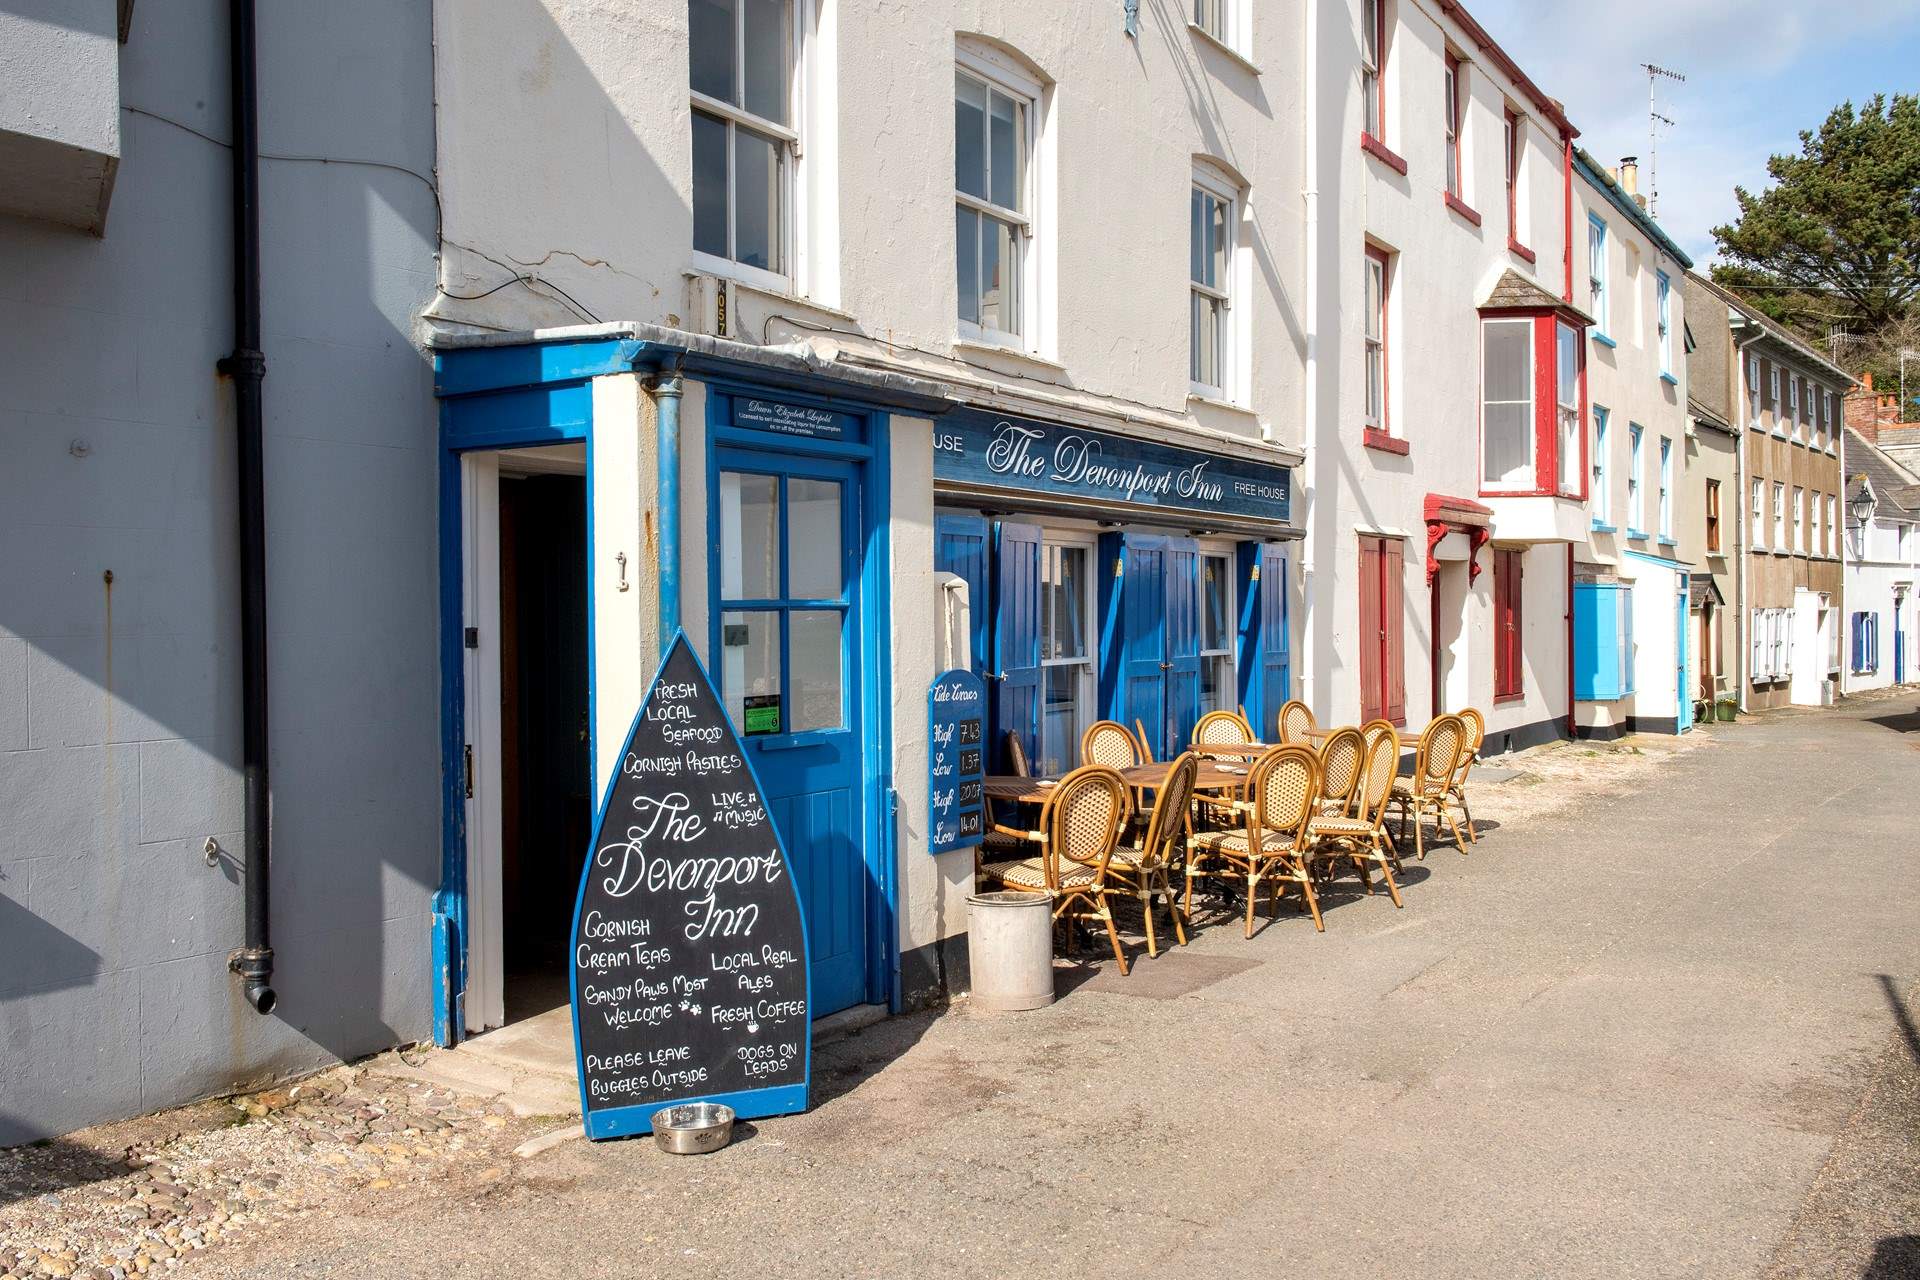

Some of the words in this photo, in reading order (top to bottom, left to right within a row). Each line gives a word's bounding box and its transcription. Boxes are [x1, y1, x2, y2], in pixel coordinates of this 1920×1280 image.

[738, 412, 758, 421] Licensed
[748, 400, 772, 414] Dawn
[774, 404, 805, 420] Elizabeth
[932, 432, 964, 452] USE
[986, 420, 1046, 477] The
[1050, 435, 1173, 502] Devonport
[1176, 460, 1224, 502] Inn
[1234, 482, 1257, 497] FREE
[1258, 485, 1286, 500] HOUSE
[655, 679, 698, 700] FRESH
[934, 684, 950, 702] Tide
[951, 683, 978, 701] Times
[646, 704, 697, 722] LOCAL
[662, 724, 723, 743] SEAFOOD
[933, 722, 954, 748] High
[624, 752, 682, 774] CORNISH
[686, 750, 742, 771] PASTIES
[933, 752, 953, 776] Low
[712, 792, 746, 806] LIVE
[933, 788, 954, 815] High
[627, 792, 706, 842] The
[726, 807, 767, 826] MUSIC
[934, 822, 956, 844] Low
[597, 840, 783, 898] Devonport
[584, 910, 650, 938] CORNISH
[684, 892, 760, 940] Inn
[576, 944, 630, 969] CREAM
[630, 942, 671, 965] TEAS
[711, 952, 760, 971] LOCAL
[762, 944, 798, 964] REAL
[584, 985, 632, 1005] SANDY
[635, 978, 668, 998] PAWS
[672, 976, 709, 994] MOST
[738, 975, 774, 990] ALES
[604, 1003, 672, 1026] WELCOME
[712, 1005, 754, 1024] FRESH
[757, 1000, 806, 1018] COFFEE
[586, 1052, 644, 1073] PLEASE
[649, 1046, 692, 1064] LEAVE
[737, 1045, 774, 1060] DOGS
[780, 1043, 798, 1057] ON
[744, 1059, 788, 1076] LEADS
[591, 1075, 648, 1096] BUGGIES
[651, 1068, 708, 1087] OUTSIDE
